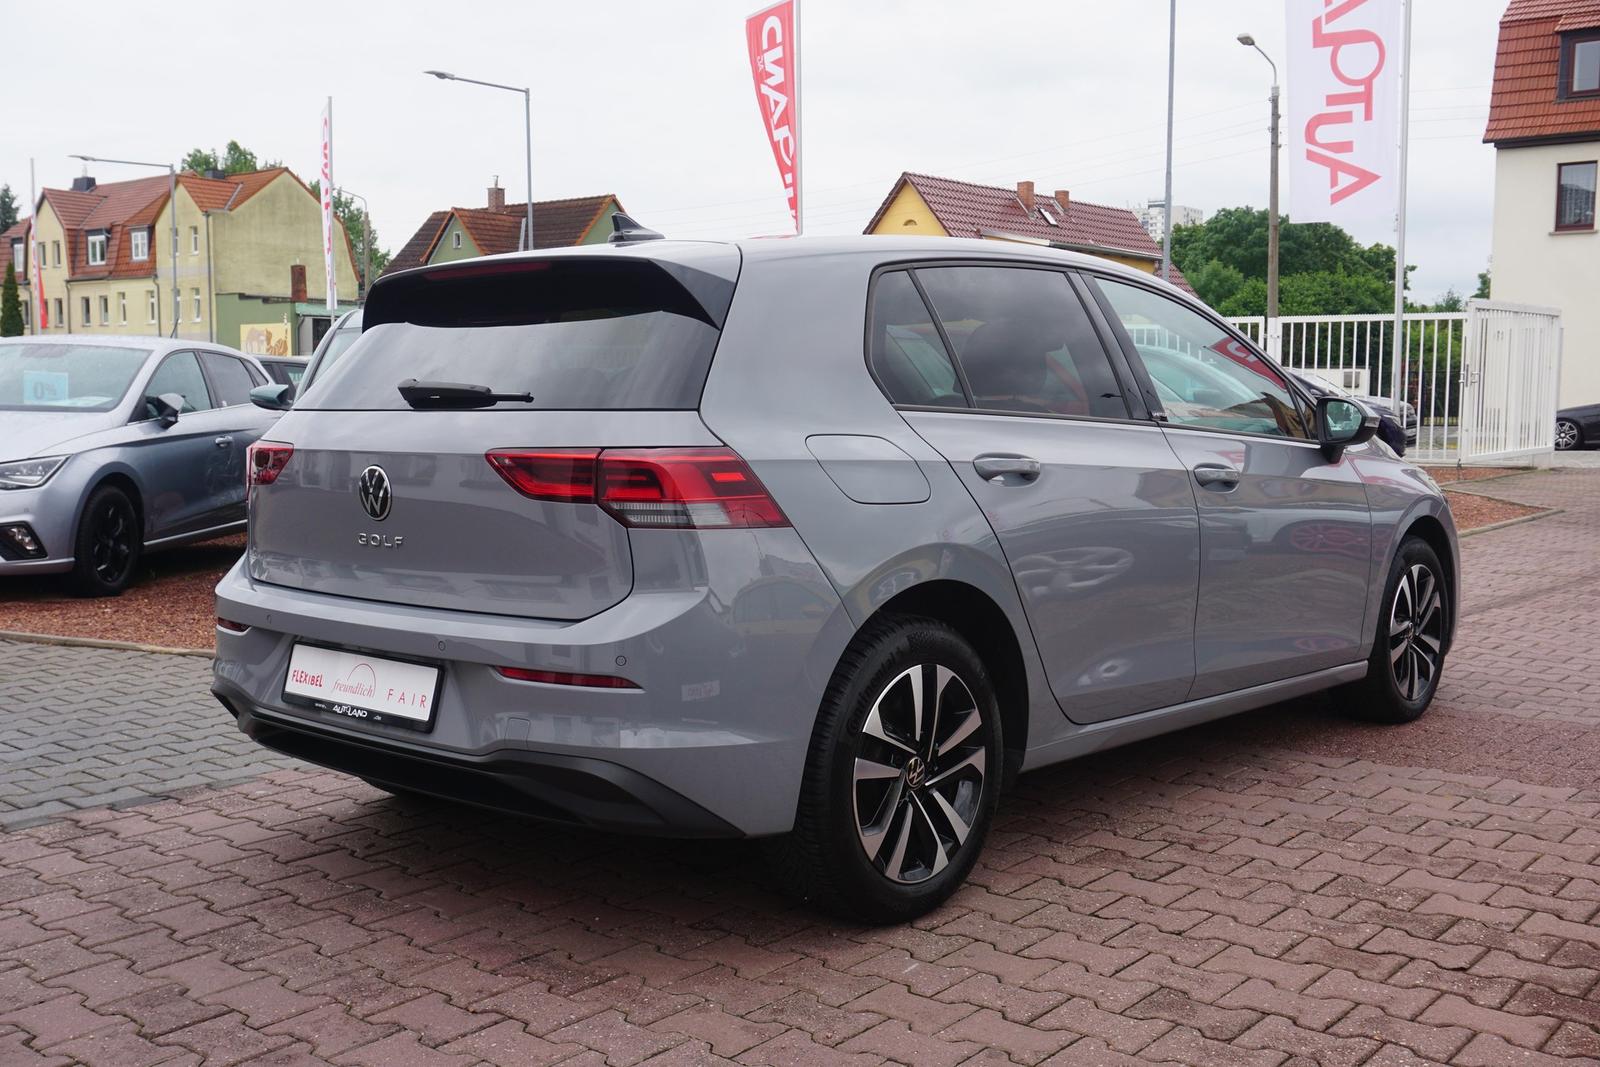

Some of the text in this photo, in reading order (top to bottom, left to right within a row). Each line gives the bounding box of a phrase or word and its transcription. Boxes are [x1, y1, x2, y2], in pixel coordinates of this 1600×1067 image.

[358, 533, 403, 548] GOLF
[332, 679, 375, 698] freundlich
[333, 704, 368, 718] AUTOLAND
